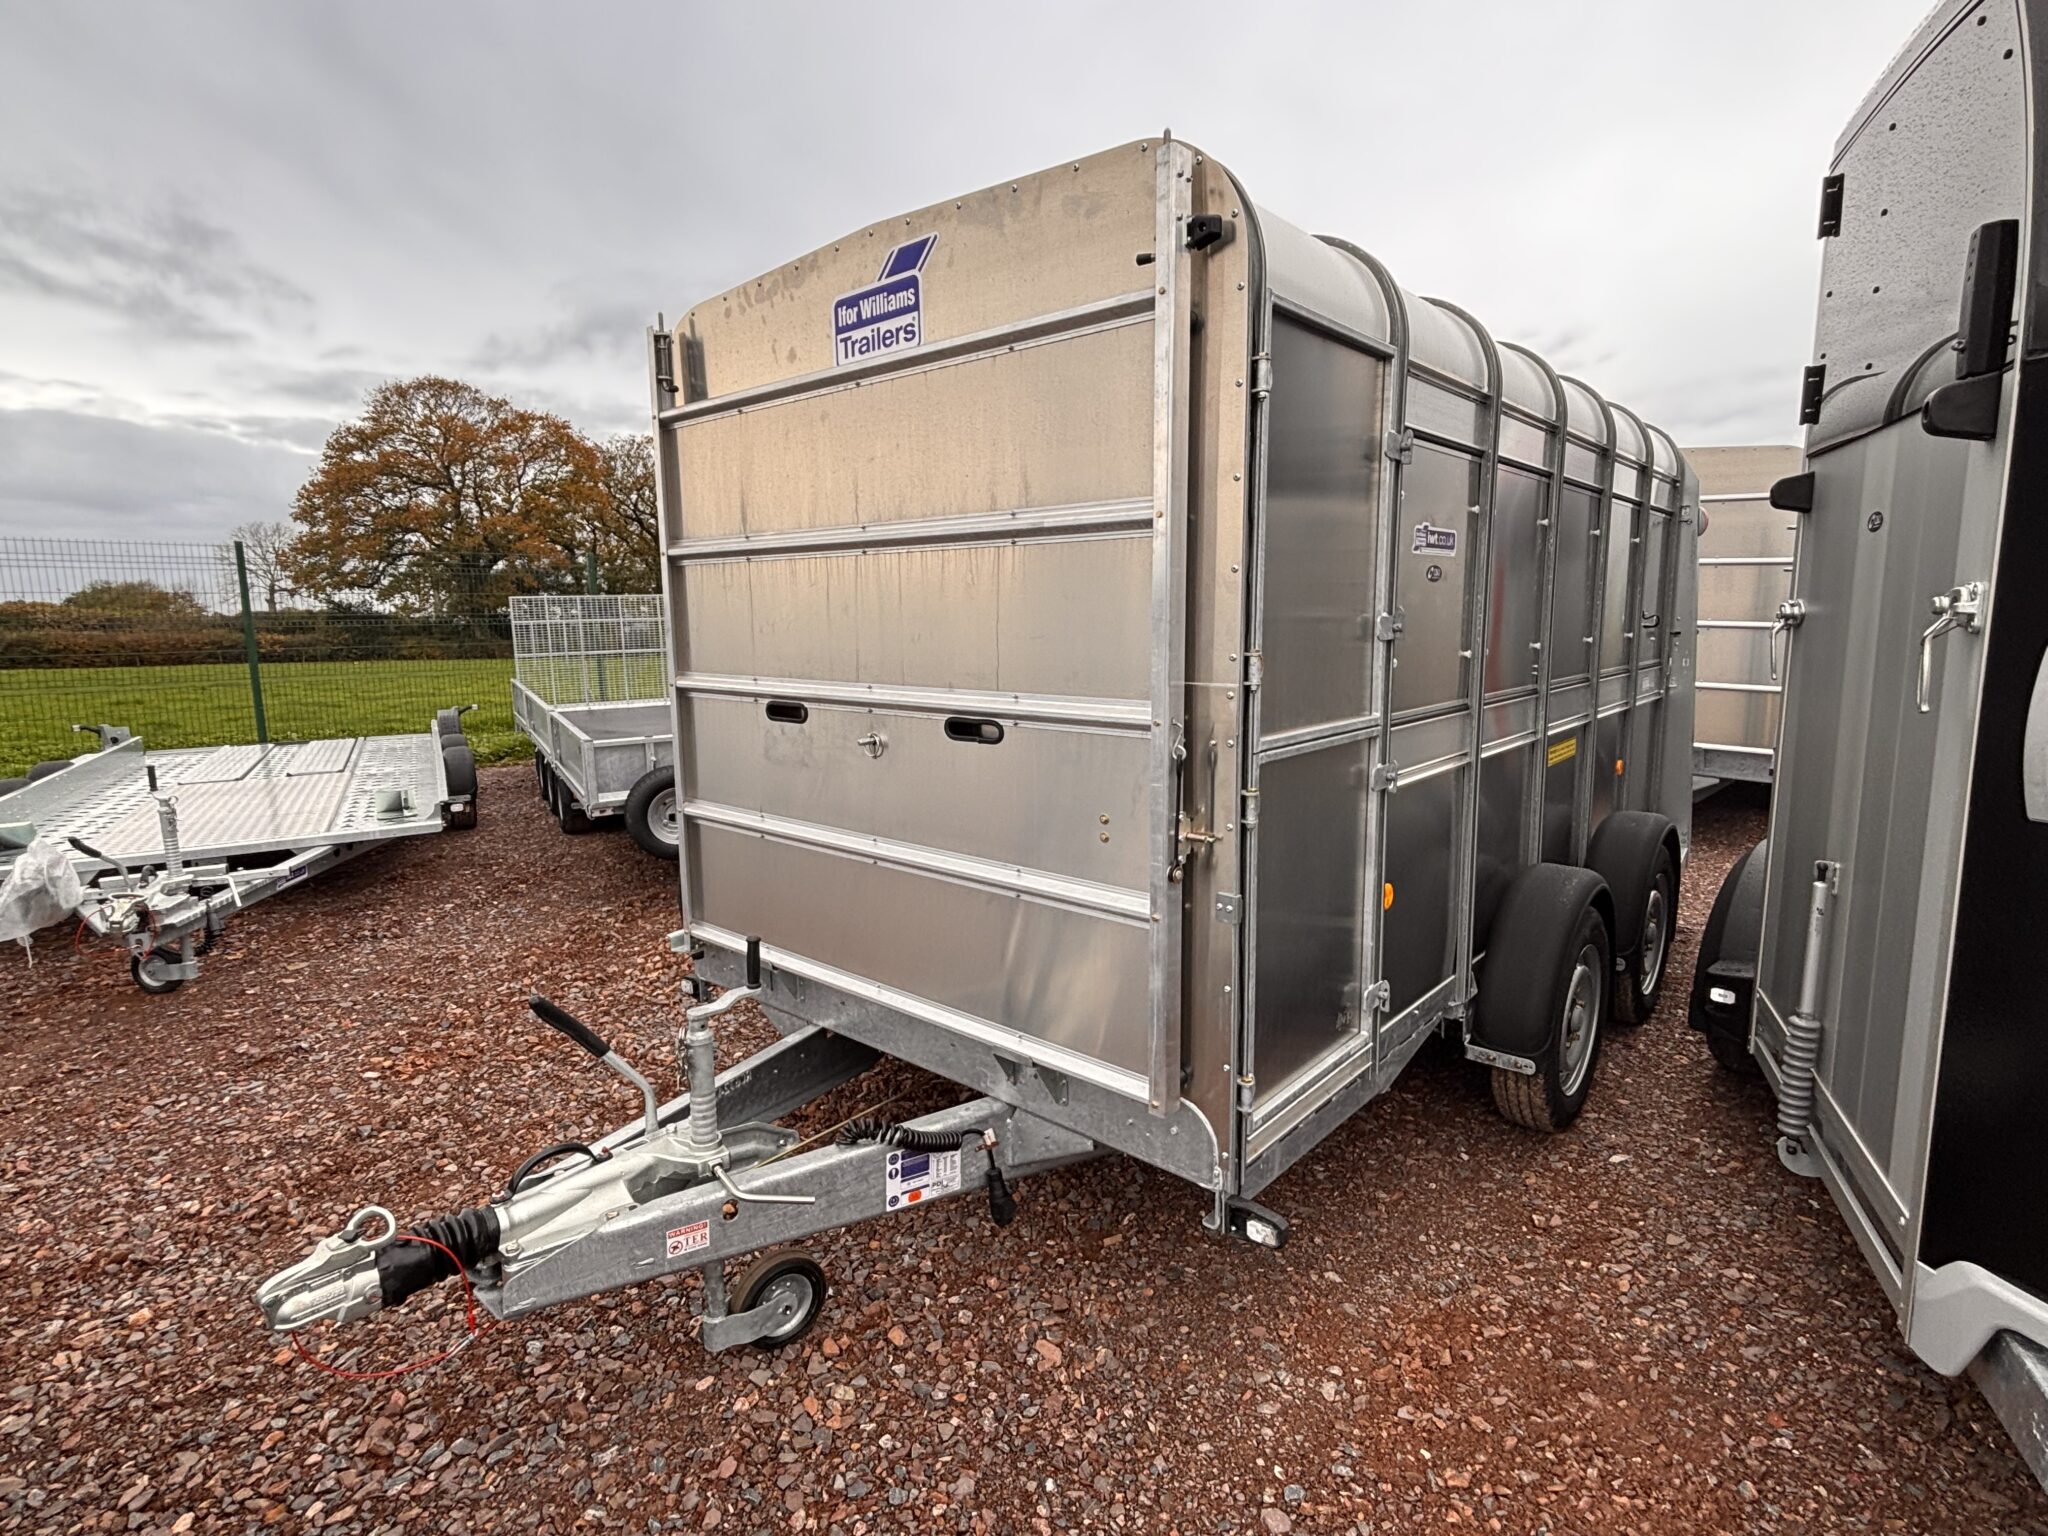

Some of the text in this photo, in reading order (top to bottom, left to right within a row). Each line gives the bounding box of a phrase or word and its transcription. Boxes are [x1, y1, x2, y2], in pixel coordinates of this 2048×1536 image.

[838, 287, 915, 328] Ifor Williams
[839, 322, 917, 359] Trailers
[1427, 531, 1454, 546] iwt.co.uk
[668, 1221, 708, 1239] WARNING!
[684, 1232, 707, 1246] TER
